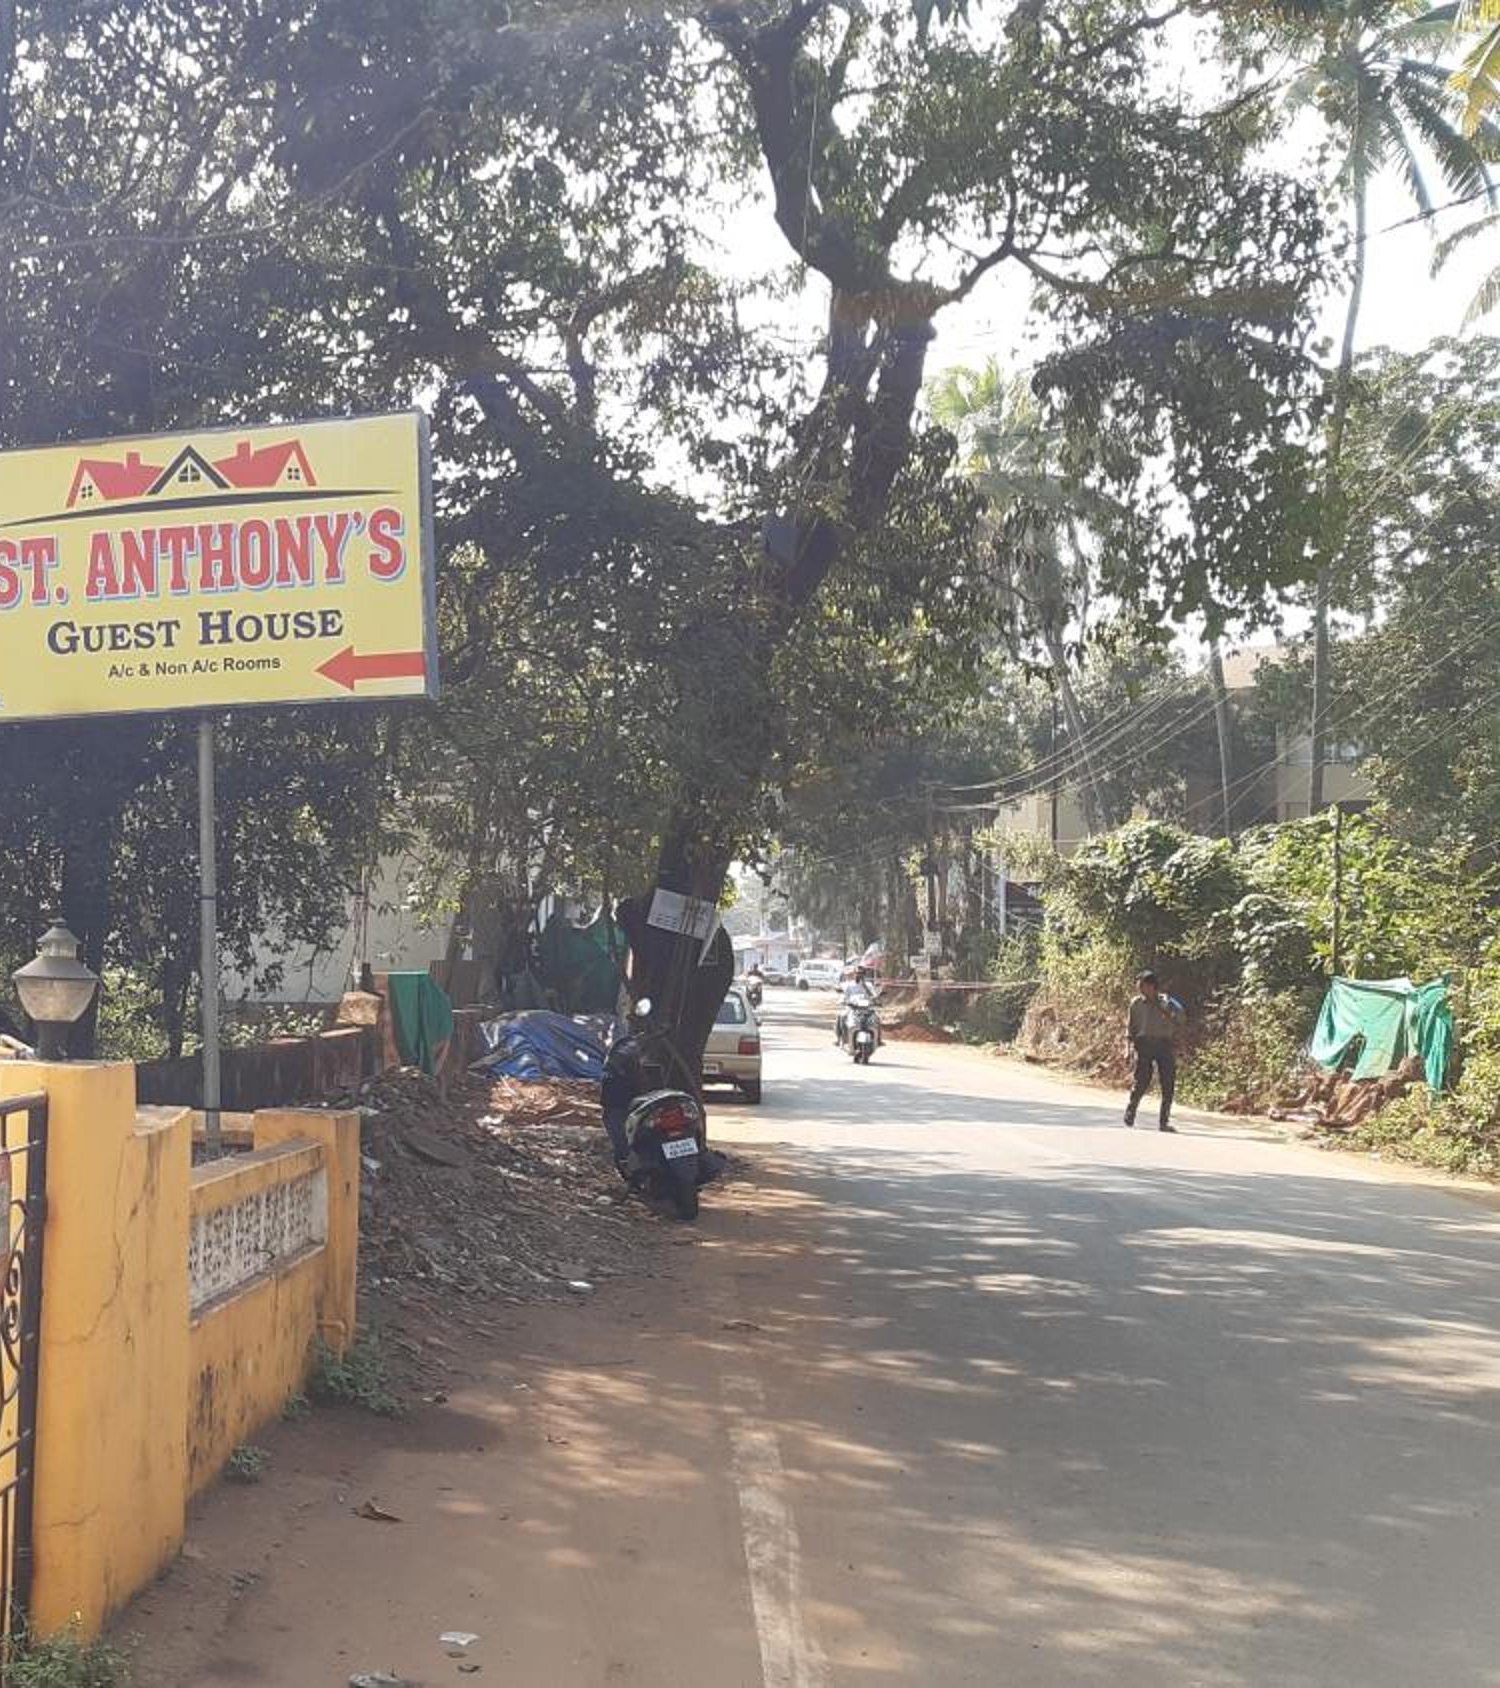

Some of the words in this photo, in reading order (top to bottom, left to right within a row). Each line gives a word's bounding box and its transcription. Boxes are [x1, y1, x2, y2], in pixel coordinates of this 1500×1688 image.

[85, 508, 404, 600] ANTHONY'S
[47, 620, 181, 654] GUEST
[198, 609, 344, 645] HOUSE
[108, 664, 135, 678] A/c
[139, 663, 150, 676] &
[155, 661, 188, 675] Non
[191, 660, 219, 673] A/c
[223, 656, 282, 671] Rooms
